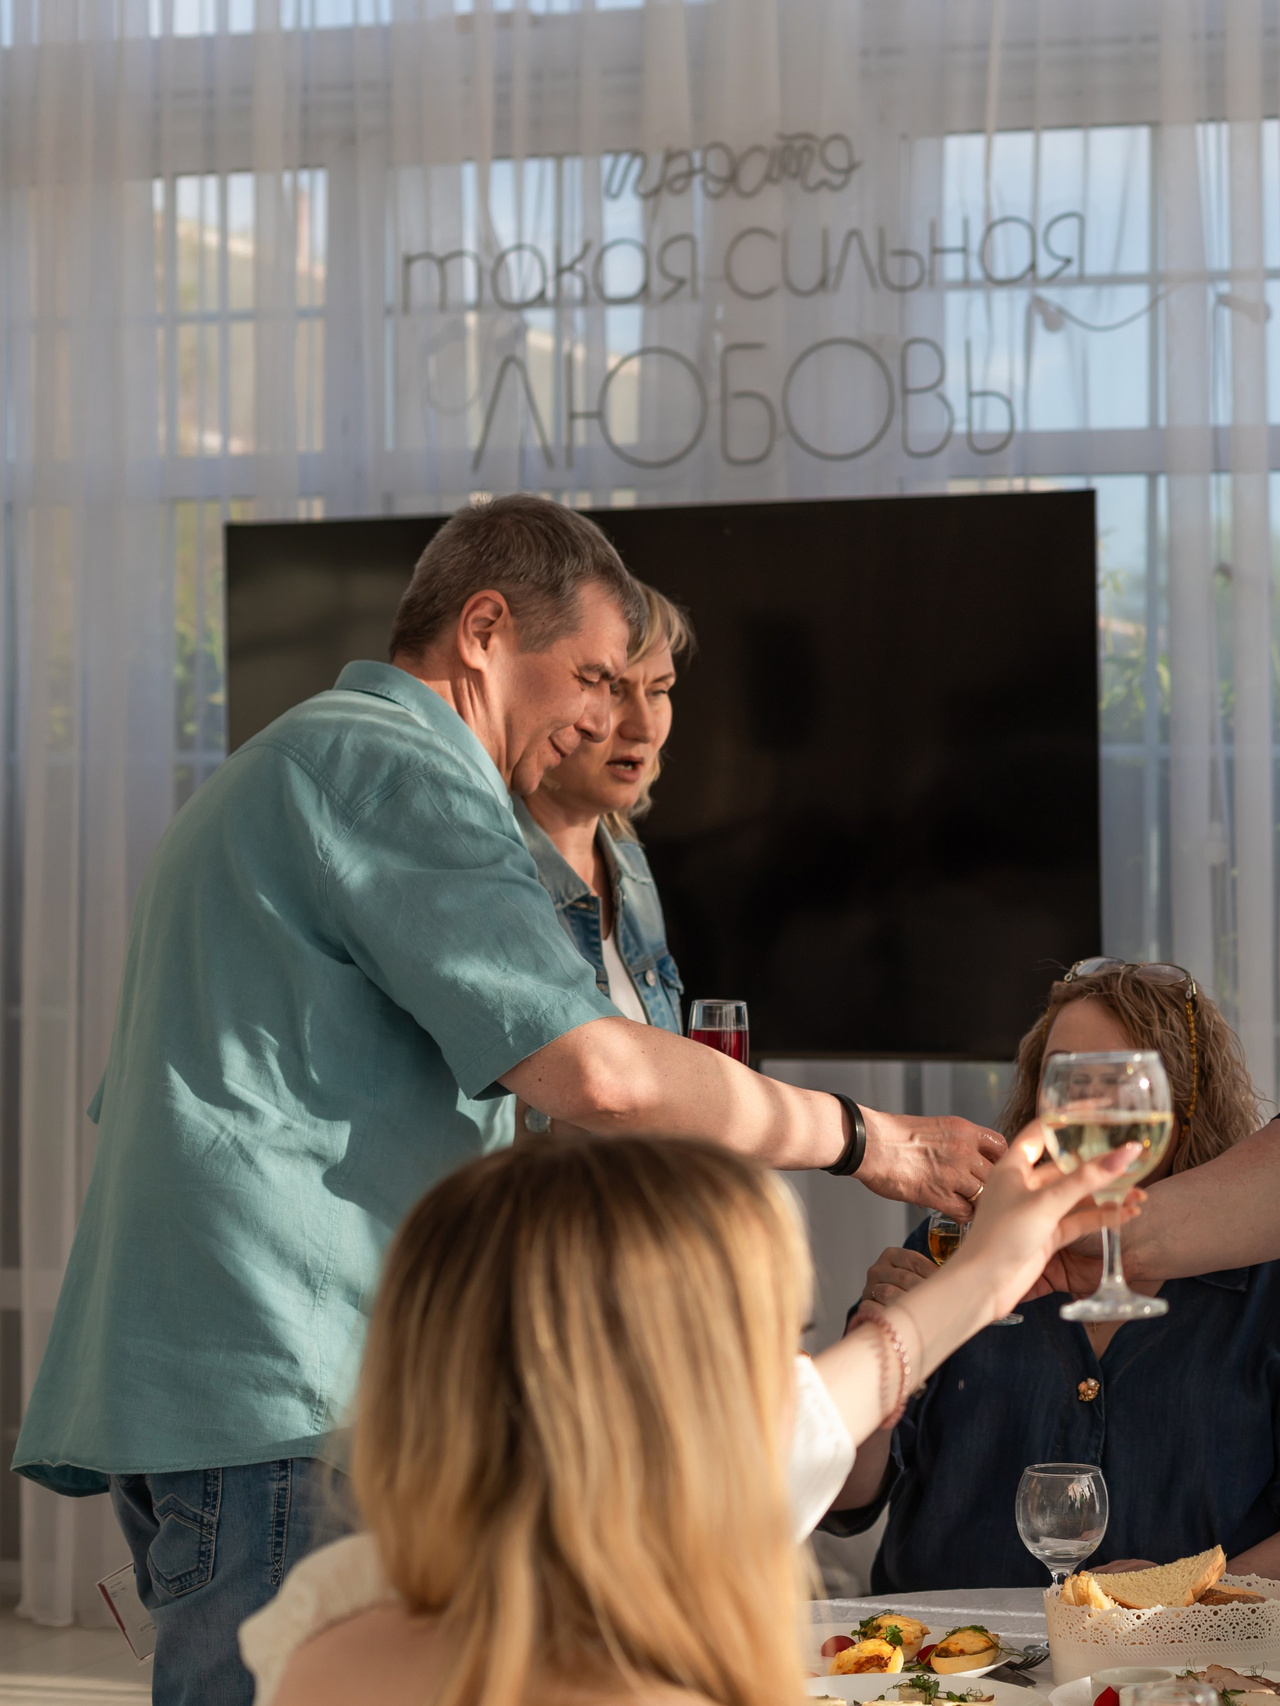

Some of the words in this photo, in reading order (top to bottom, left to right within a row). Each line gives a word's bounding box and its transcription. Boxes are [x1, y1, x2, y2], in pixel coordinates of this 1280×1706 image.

[402, 233, 697, 313] такая
[724, 211, 1085, 301] сильная
[471, 337, 1016, 472] ЛЮБОВЬ
